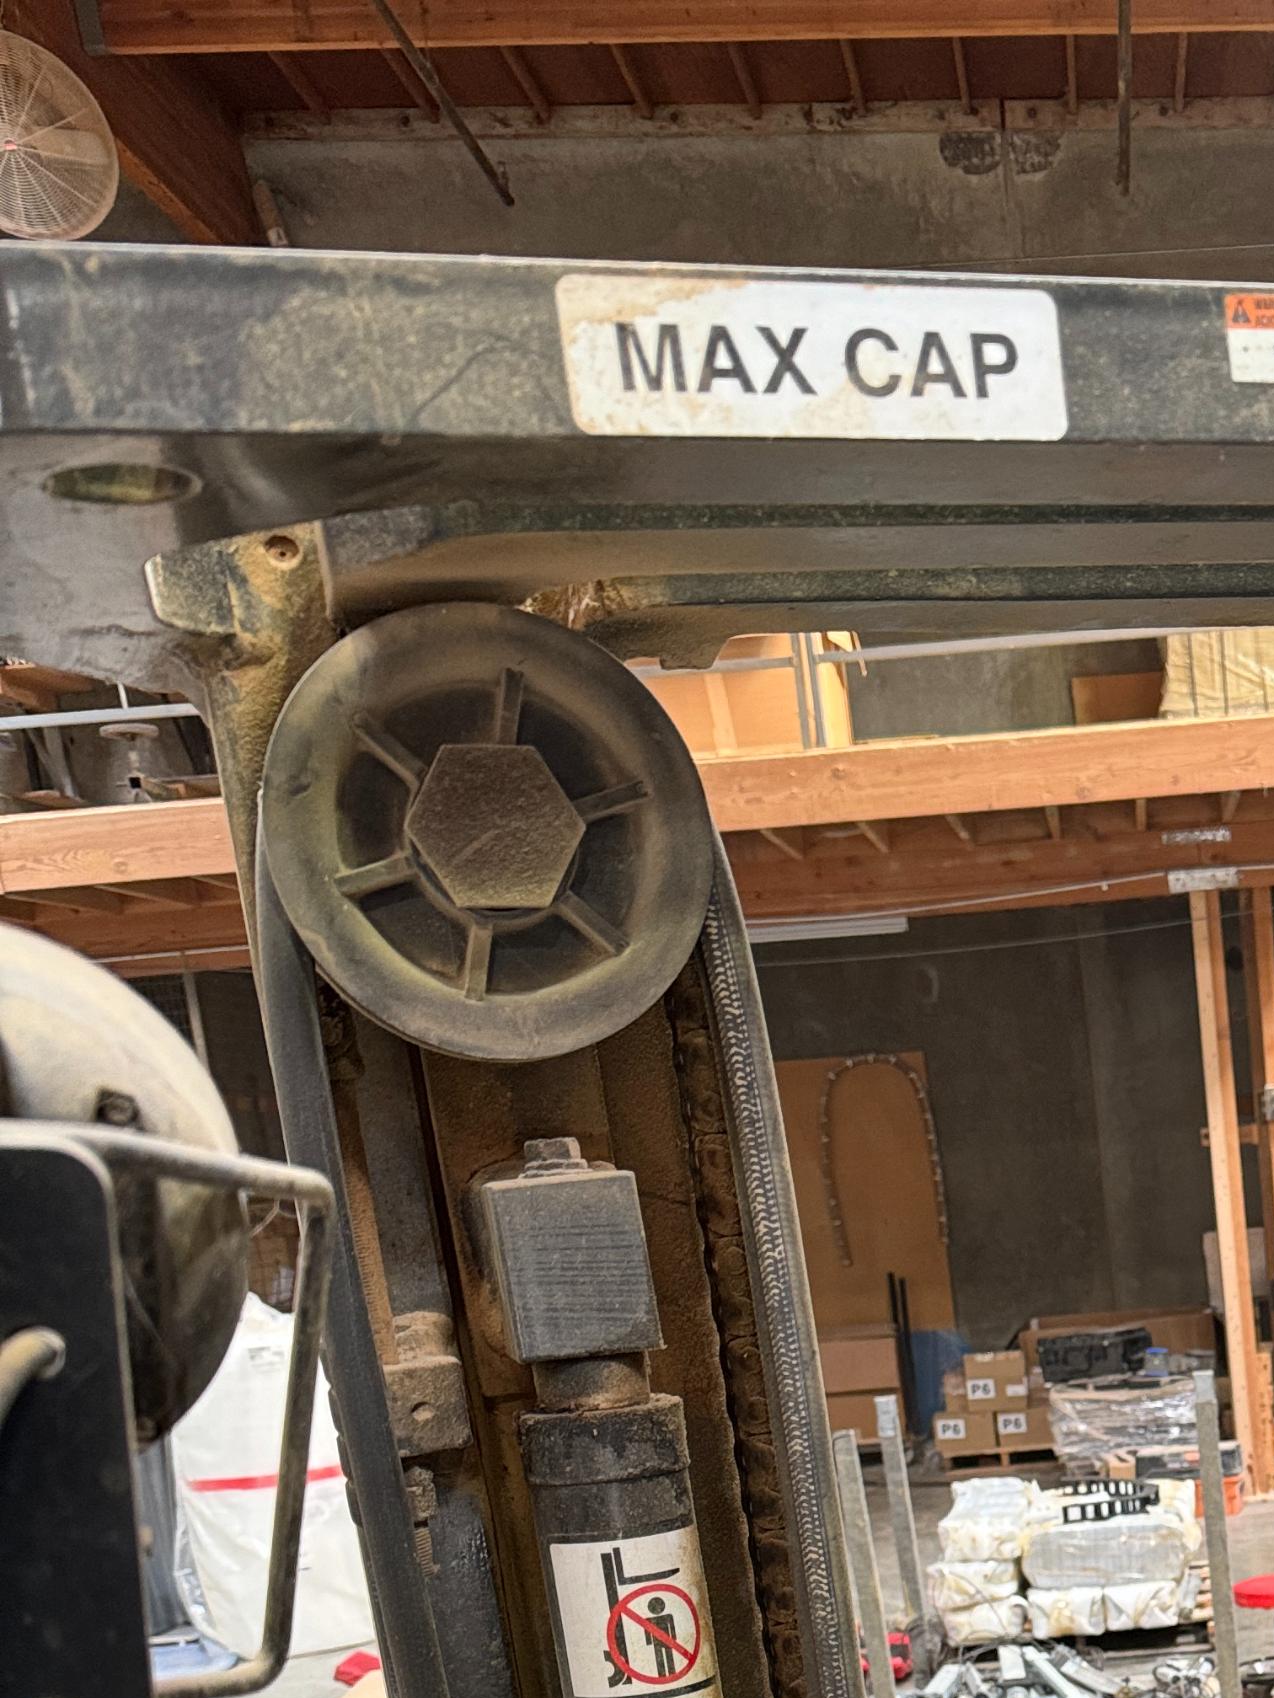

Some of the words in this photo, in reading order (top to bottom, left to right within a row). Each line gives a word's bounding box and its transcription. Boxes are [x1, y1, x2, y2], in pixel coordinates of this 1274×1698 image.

[615, 321, 818, 396] MAX
[843, 327, 1019, 400] CAP
[971, 1383, 991, 1396] P6
[941, 1423, 961, 1436] P6
[1002, 1418, 1023, 1431] P6
